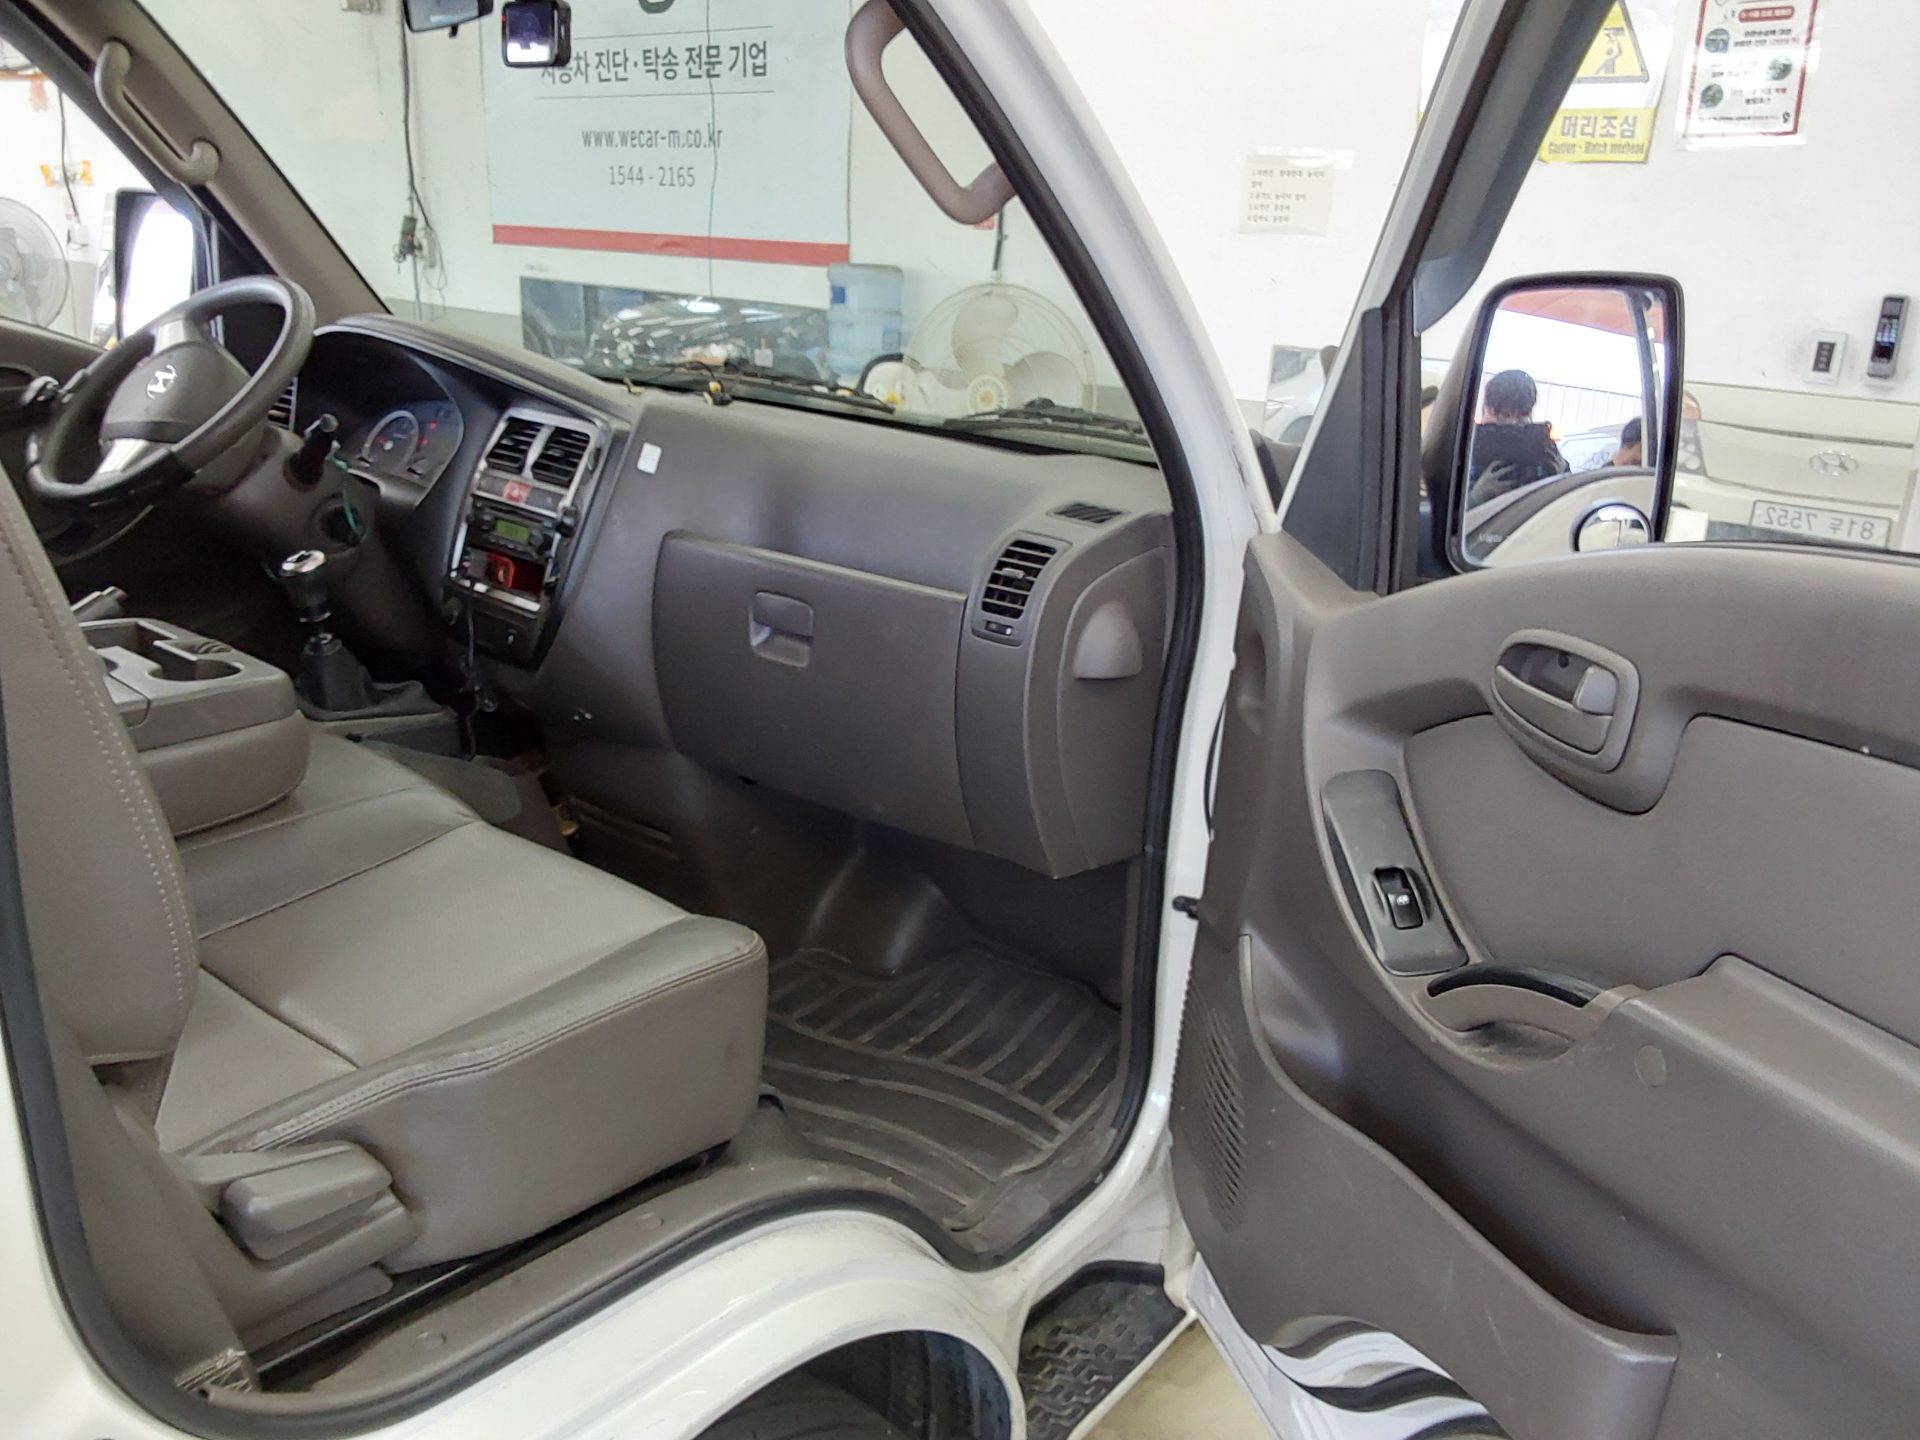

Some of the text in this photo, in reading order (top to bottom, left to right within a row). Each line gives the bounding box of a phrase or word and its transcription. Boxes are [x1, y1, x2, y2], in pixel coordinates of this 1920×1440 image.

[685, 44, 723, 80] 전문
[728, 41, 767, 78] 기업
[581, 122, 723, 149] www.wecar-m.co.kr
[1560, 115, 1638, 139] 머리조심
